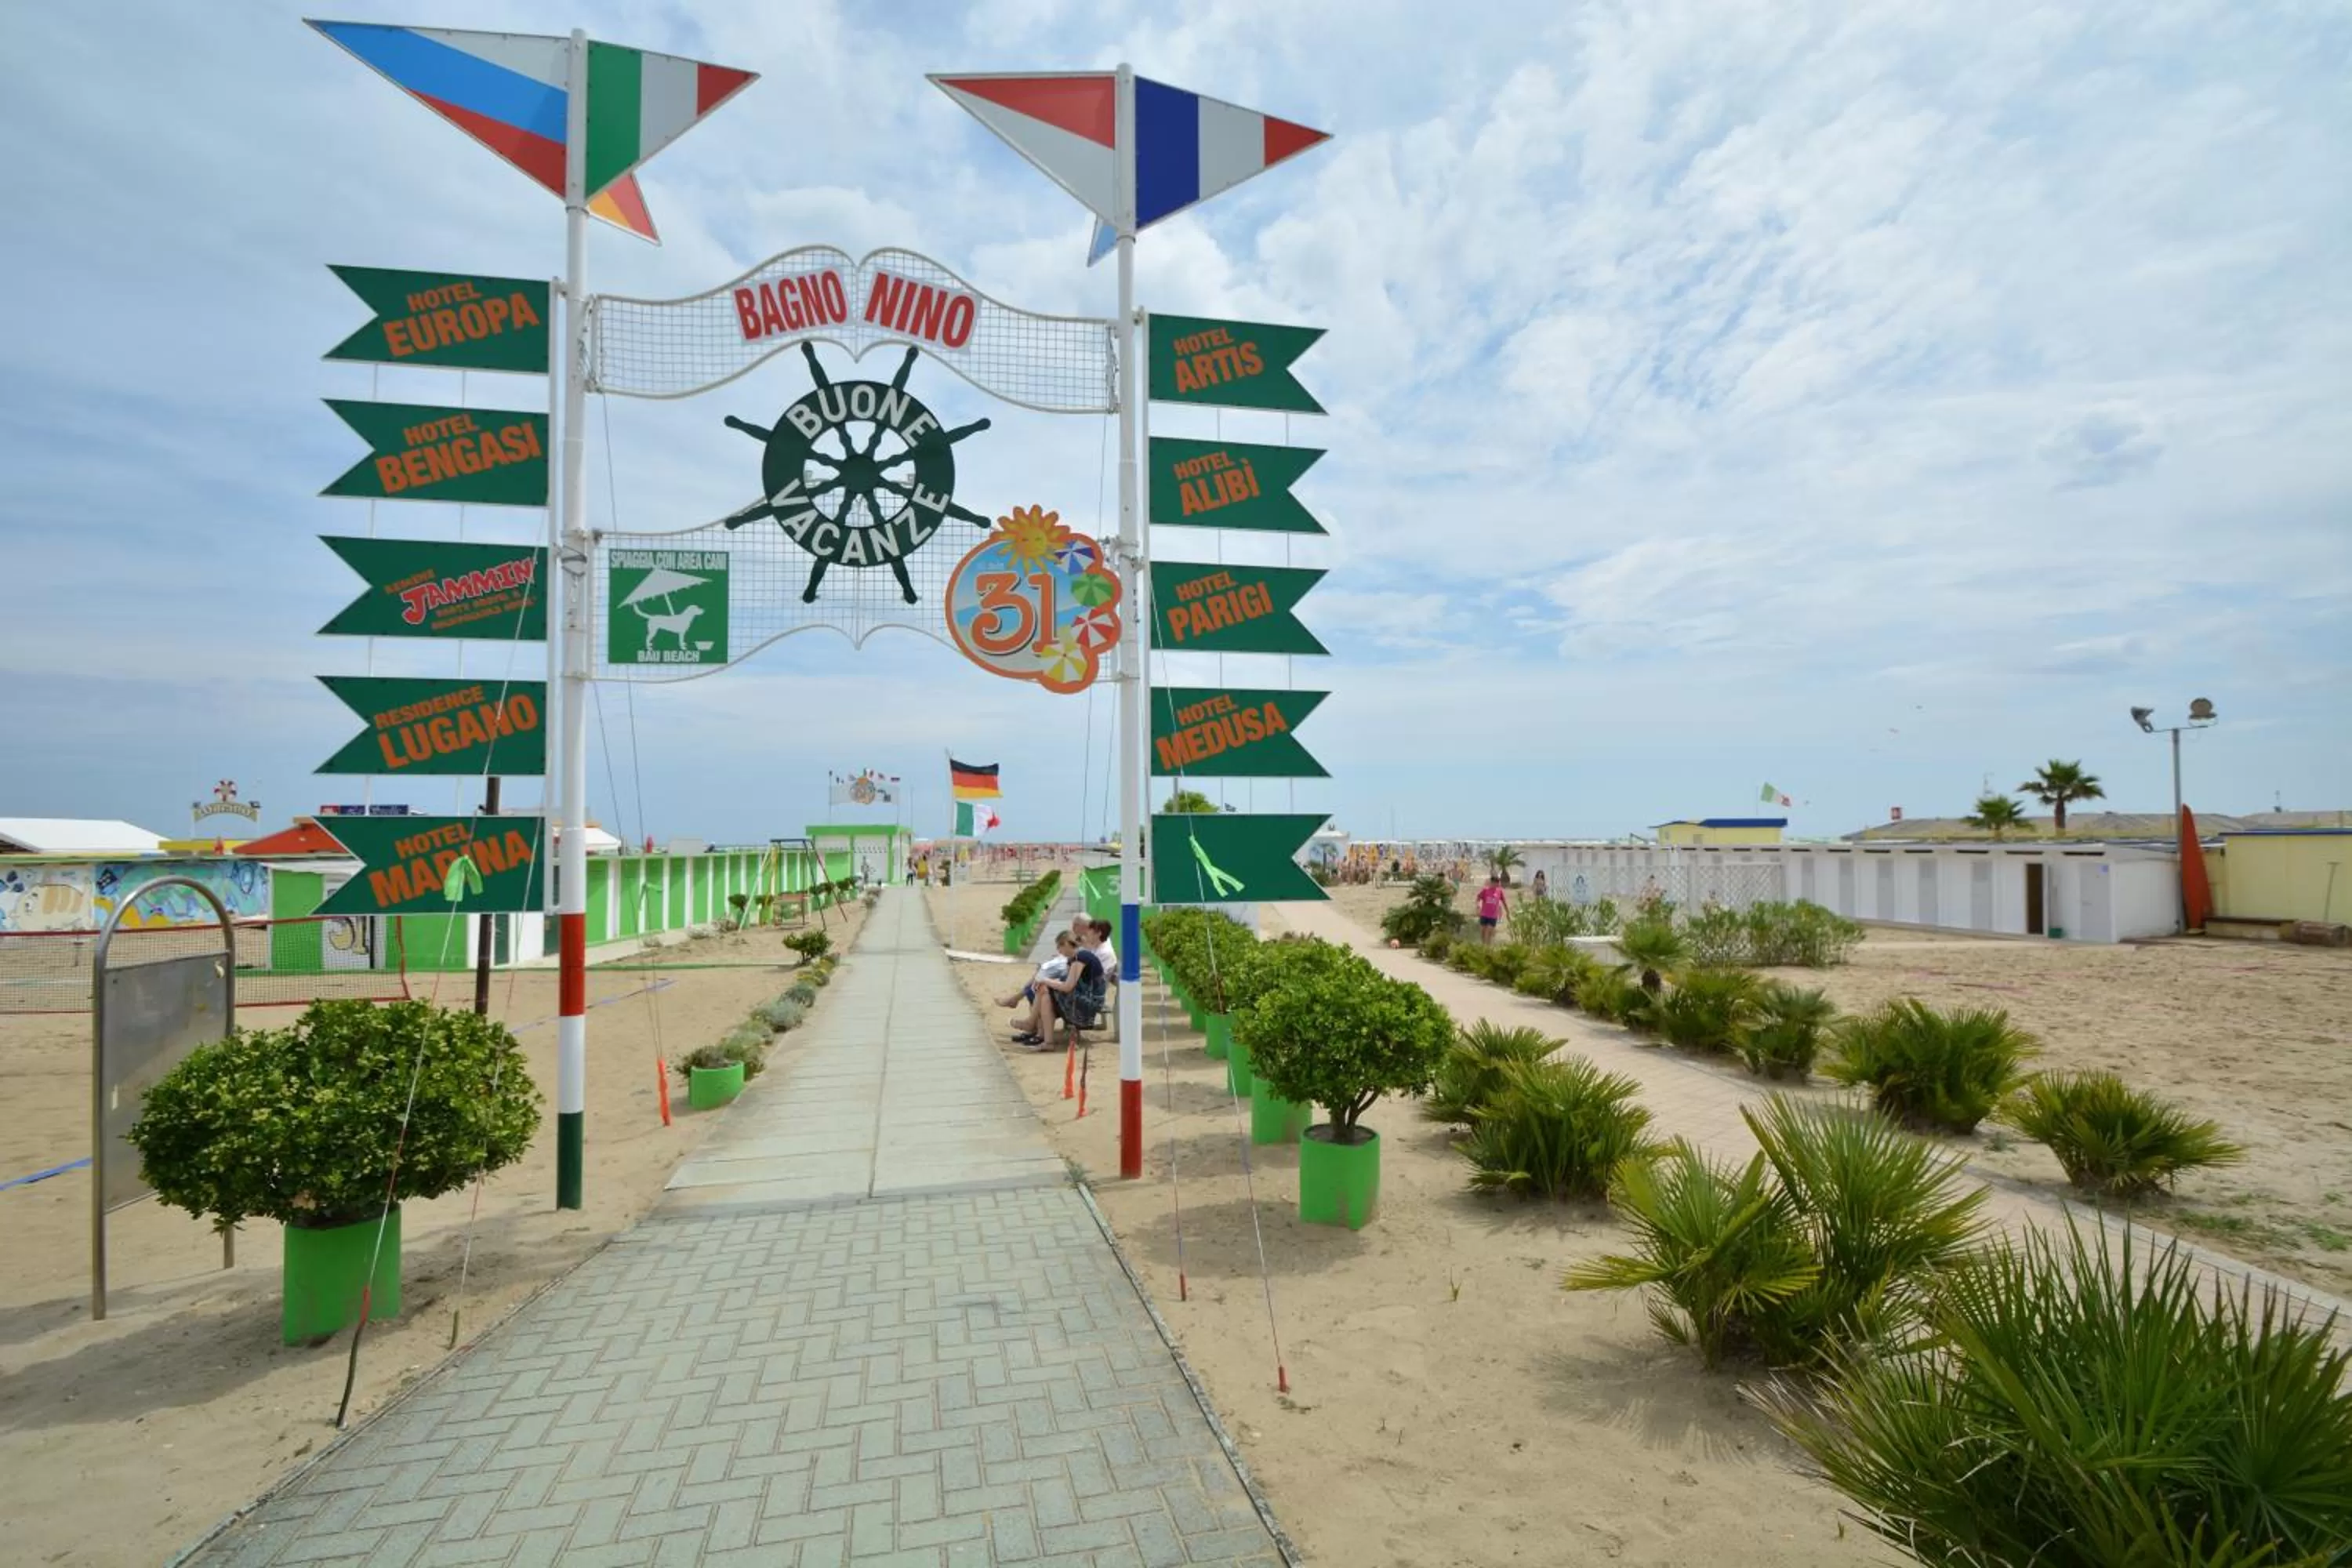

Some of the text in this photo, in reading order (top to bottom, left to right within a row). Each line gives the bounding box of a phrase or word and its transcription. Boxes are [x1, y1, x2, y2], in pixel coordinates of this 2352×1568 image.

[406, 281, 483, 312] HOTEL
[734, 270, 976, 349] BAGNO NINO
[383, 292, 540, 358] EUROPA
[1174, 326, 1235, 355] HOTEL
[1175, 342, 1265, 393] ARTIS
[402, 413, 481, 447] HOTEL
[785, 384, 939, 448] BUONE
[375, 421, 541, 494] BENGASI
[1174, 450, 1236, 480] HOTEL
[770, 477, 949, 564] VACANZE
[1166, 581, 1274, 641] PARIGI
[1176, 571, 1238, 602] HOTEL
[971, 570, 1058, 655] 31
[663, 650, 700, 662] BEACH
[375, 685, 484, 730] RESIDENCE
[376, 694, 539, 770] LUGANO
[1178, 694, 1238, 725] HOTEL
[1156, 702, 1287, 771] MEDUSA
[394, 822, 472, 859] HOTEL
